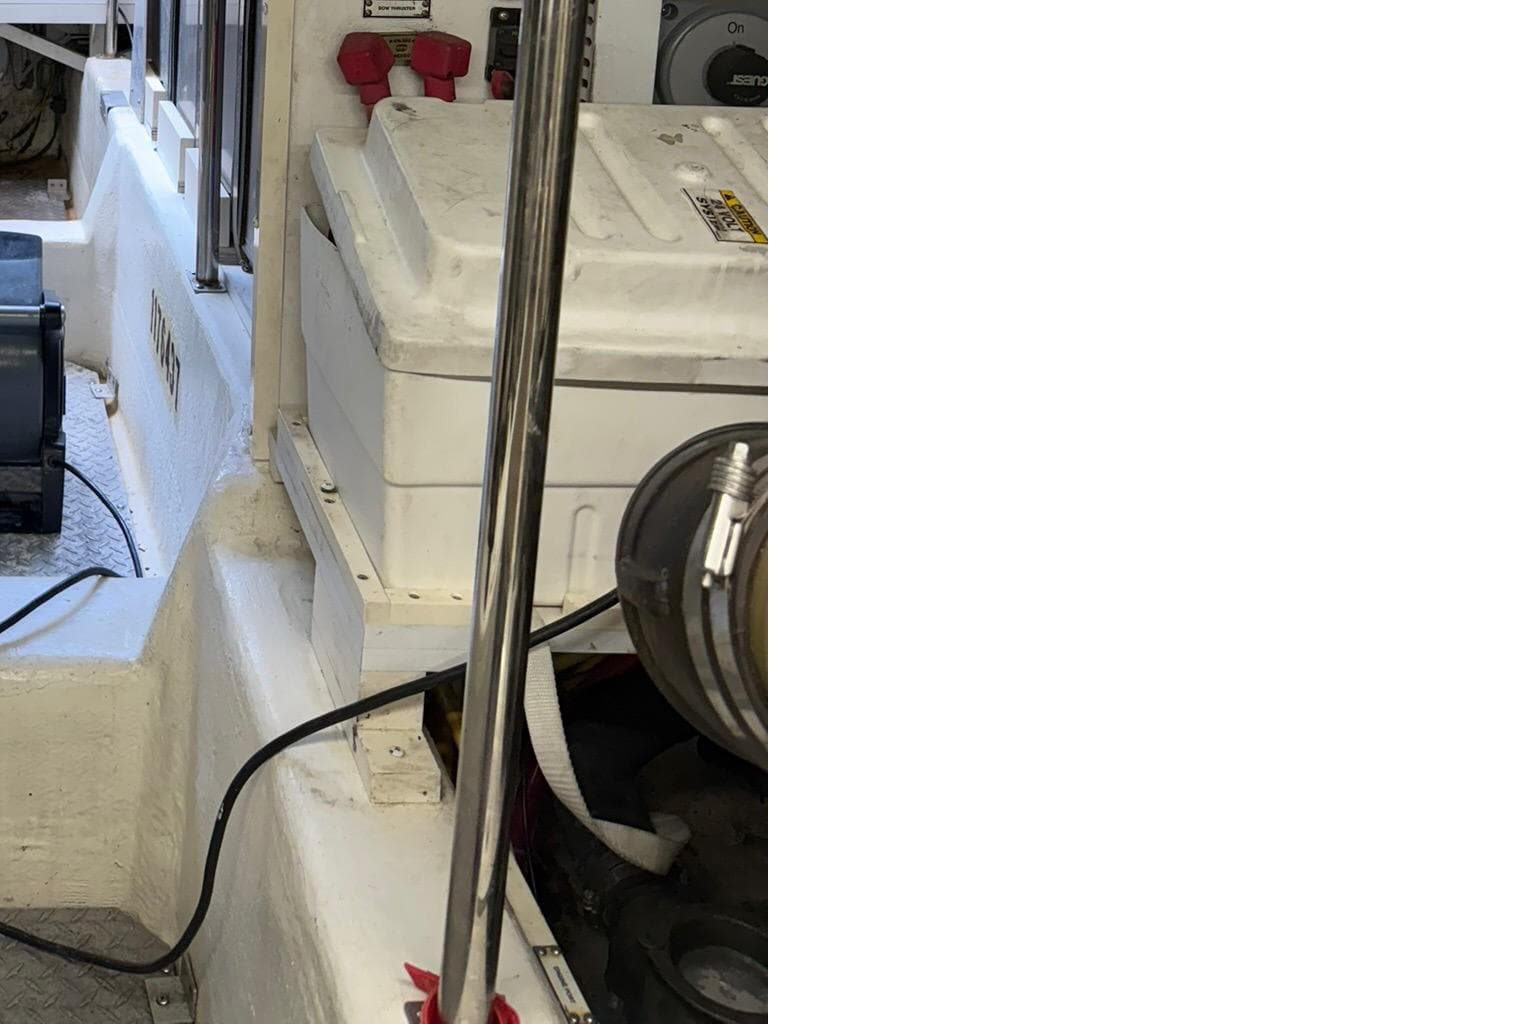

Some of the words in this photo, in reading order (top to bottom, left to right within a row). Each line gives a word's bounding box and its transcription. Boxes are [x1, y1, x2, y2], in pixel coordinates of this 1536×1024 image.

[727, 21, 745, 34] On
[731, 74, 768, 87] GUEST
[718, 211, 745, 232] VOLT
[730, 204, 761, 235] CAUTION
